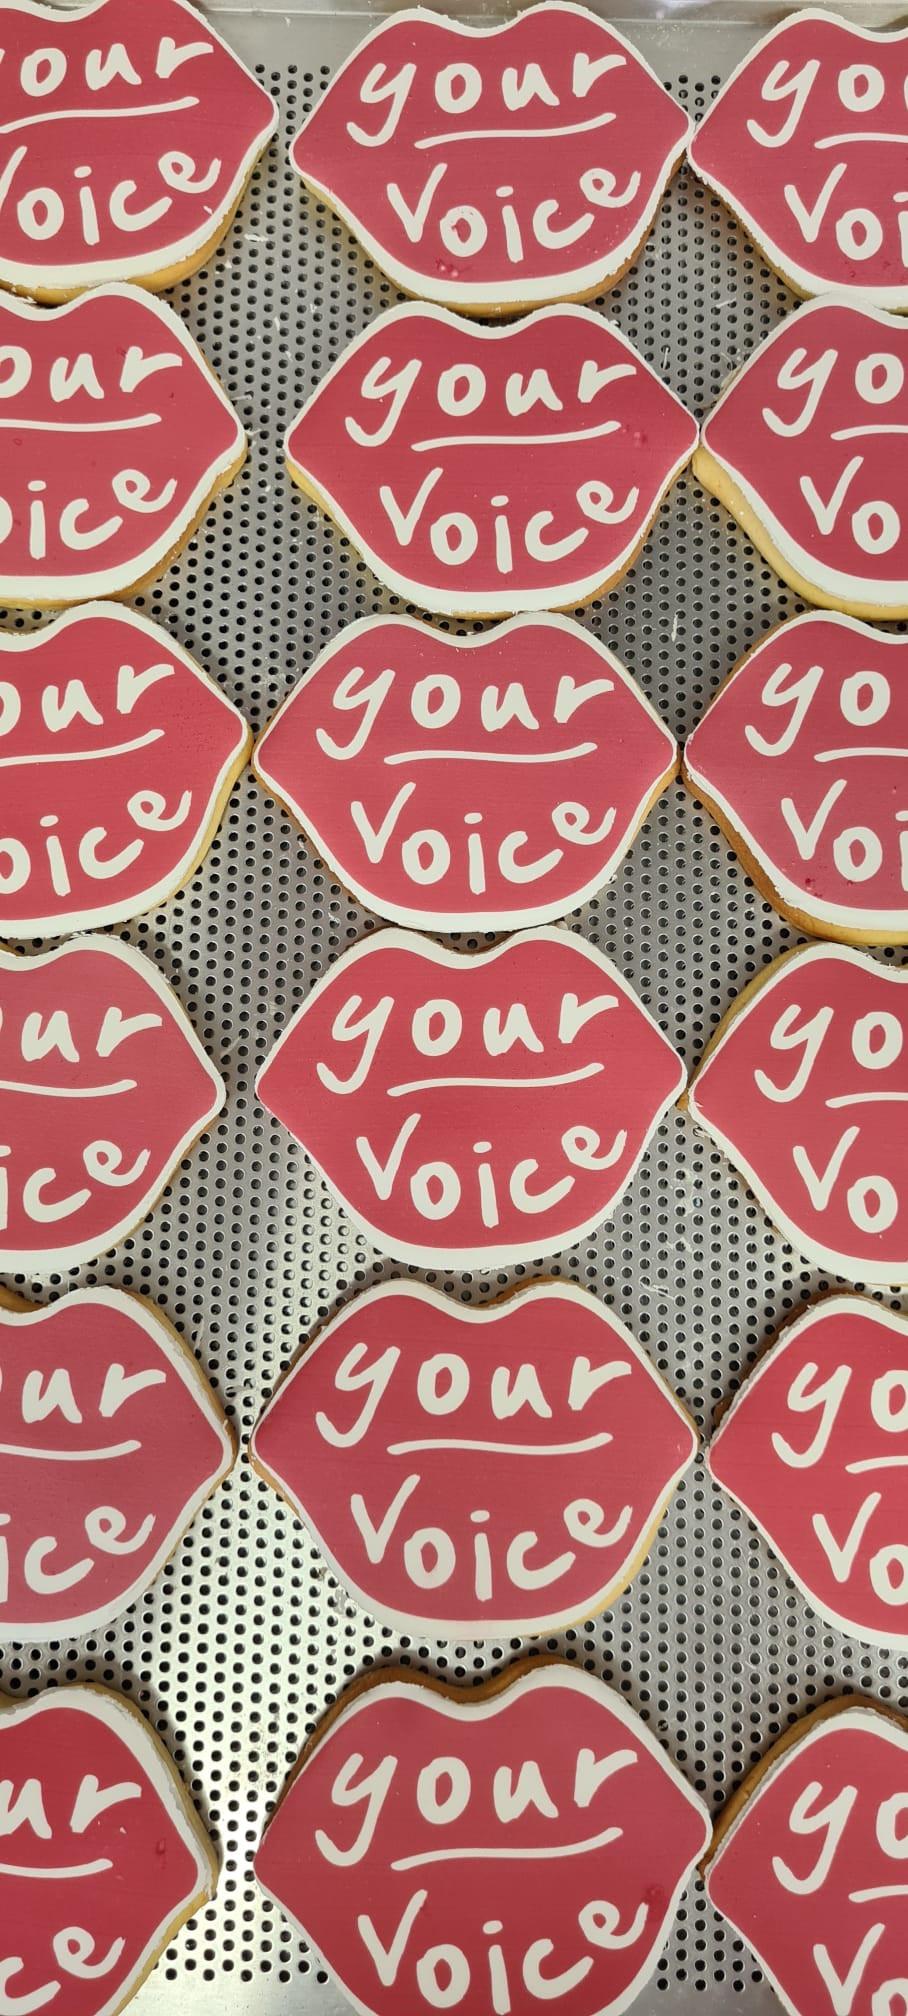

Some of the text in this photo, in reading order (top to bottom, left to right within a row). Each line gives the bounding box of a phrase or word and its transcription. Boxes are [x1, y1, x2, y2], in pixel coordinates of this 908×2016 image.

[0, 36, 214, 97] our
[346, 52, 627, 148] your
[746, 59, 908, 148] yo
[386, 162, 641, 264] Voice
[344, 356, 637, 447] your
[762, 347, 905, 437] yo
[0, 468, 177, 560] ice
[379, 467, 639, 574] Voice
[315, 666, 615, 760] your
[744, 663, 891, 757] yo
[350, 782, 617, 895] Voice
[0, 1006, 163, 1063] ur
[316, 992, 619, 1094] your
[754, 1004, 903, 1103] yo
[356, 1113, 627, 1228] Voice
[0, 1363, 167, 1424] ur
[315, 1343, 632, 1448] your
[350, 1474, 633, 1602] Voice
[315, 1748, 638, 1868] your
[357, 1889, 648, 2016] Voice
